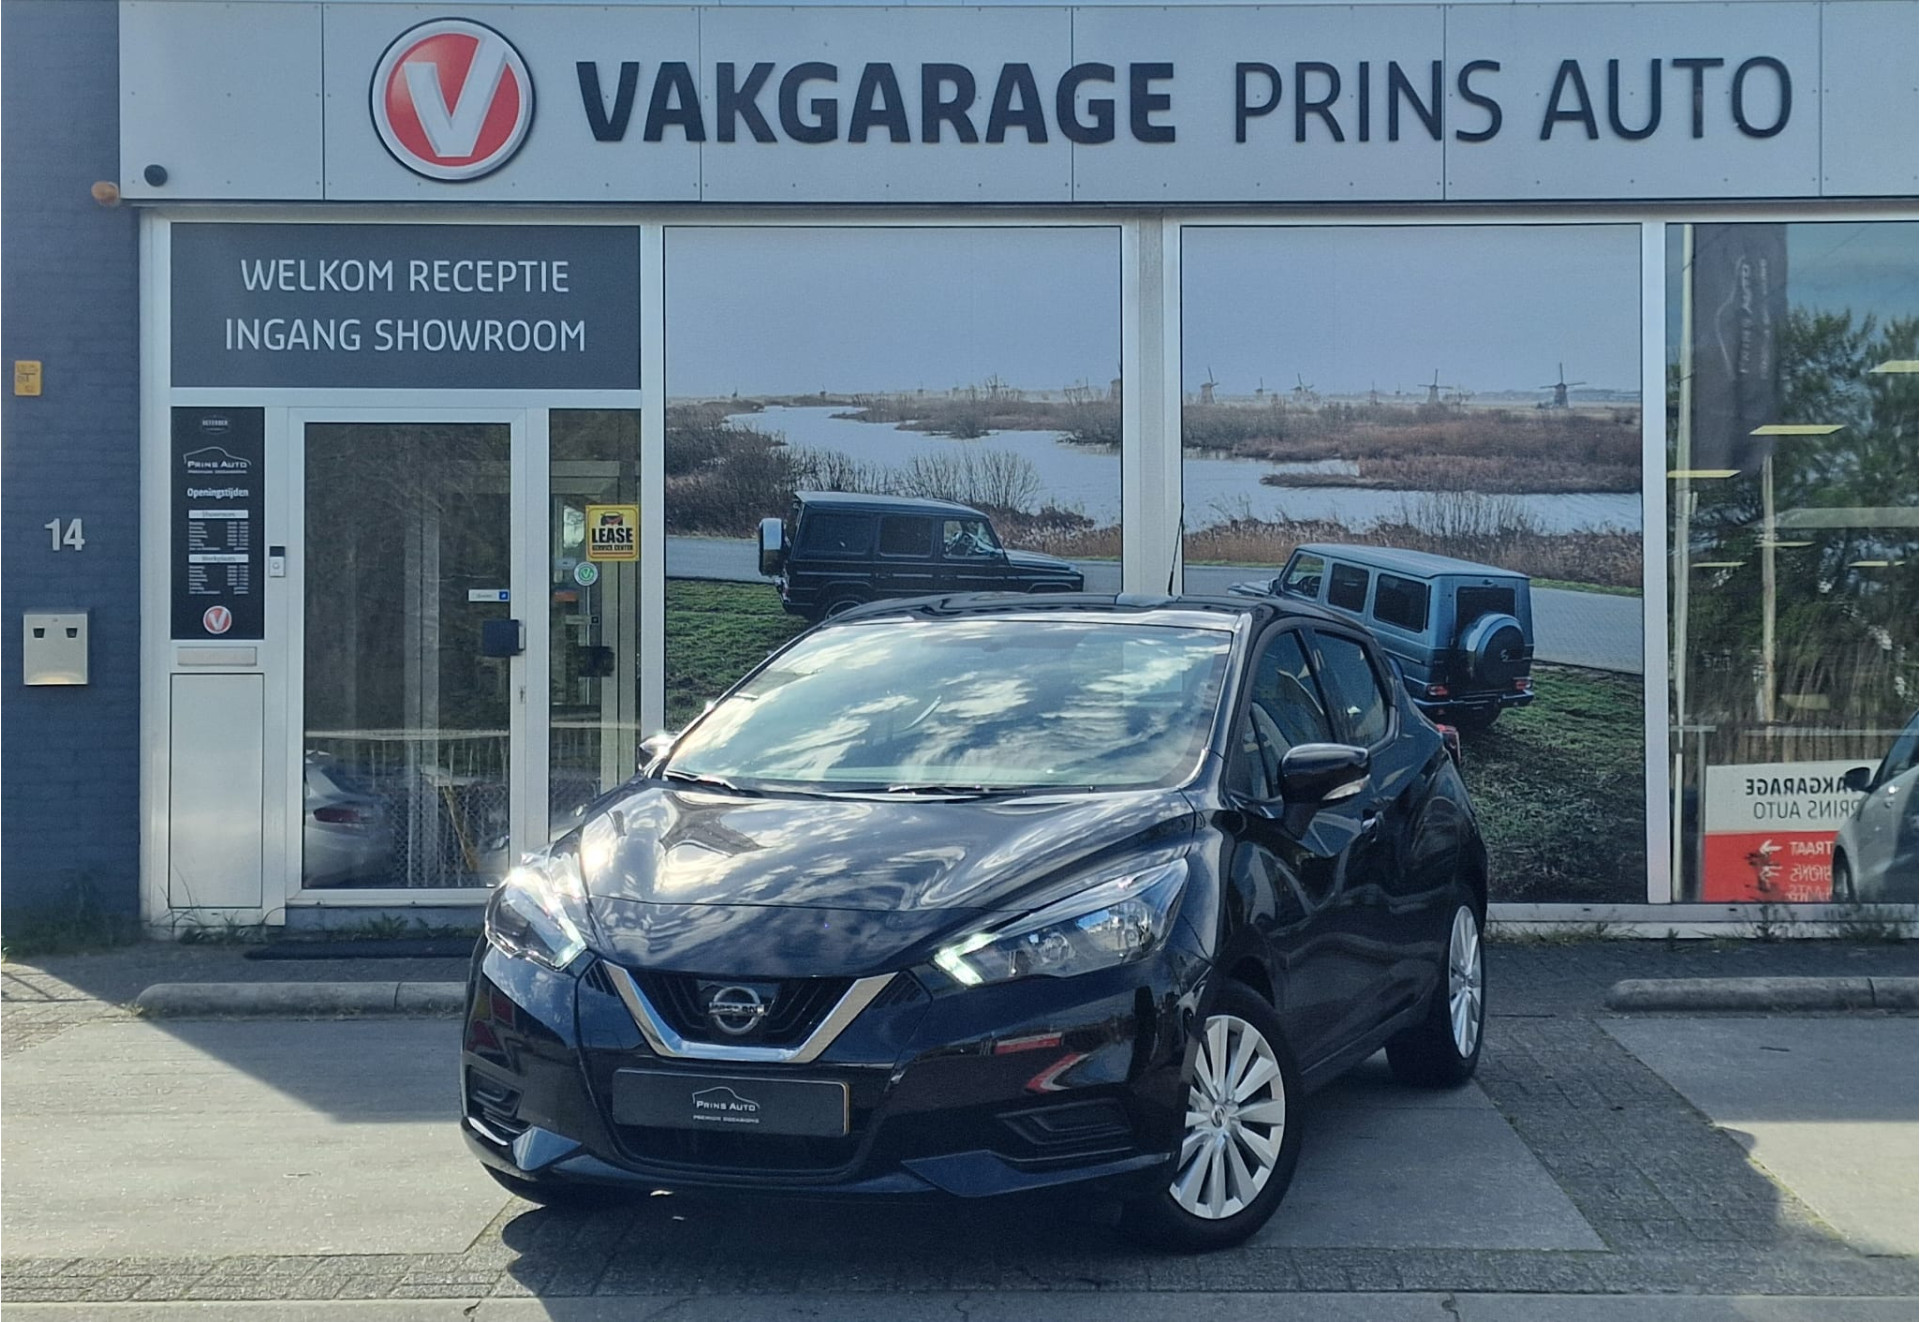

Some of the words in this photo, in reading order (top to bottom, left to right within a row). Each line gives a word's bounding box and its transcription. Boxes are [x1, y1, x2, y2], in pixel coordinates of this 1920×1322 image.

[575, 61, 1177, 145] VAKGARAGE
[1234, 59, 1503, 143] PRINS
[1539, 56, 1793, 140] AUTO
[240, 259, 394, 292] WELKOM
[409, 260, 570, 293] RECEPTIE
[225, 319, 361, 351] INGANG
[374, 319, 586, 352] SHOWROOM
[220, 460, 248, 468] AUTO
[187, 487, 249, 499] Openingstijden
[43, 518, 86, 551] 14
[591, 527, 634, 544] LEASE
[696, 1100, 727, 1110] PRINS
[729, 1102, 756, 1112] AUTO
